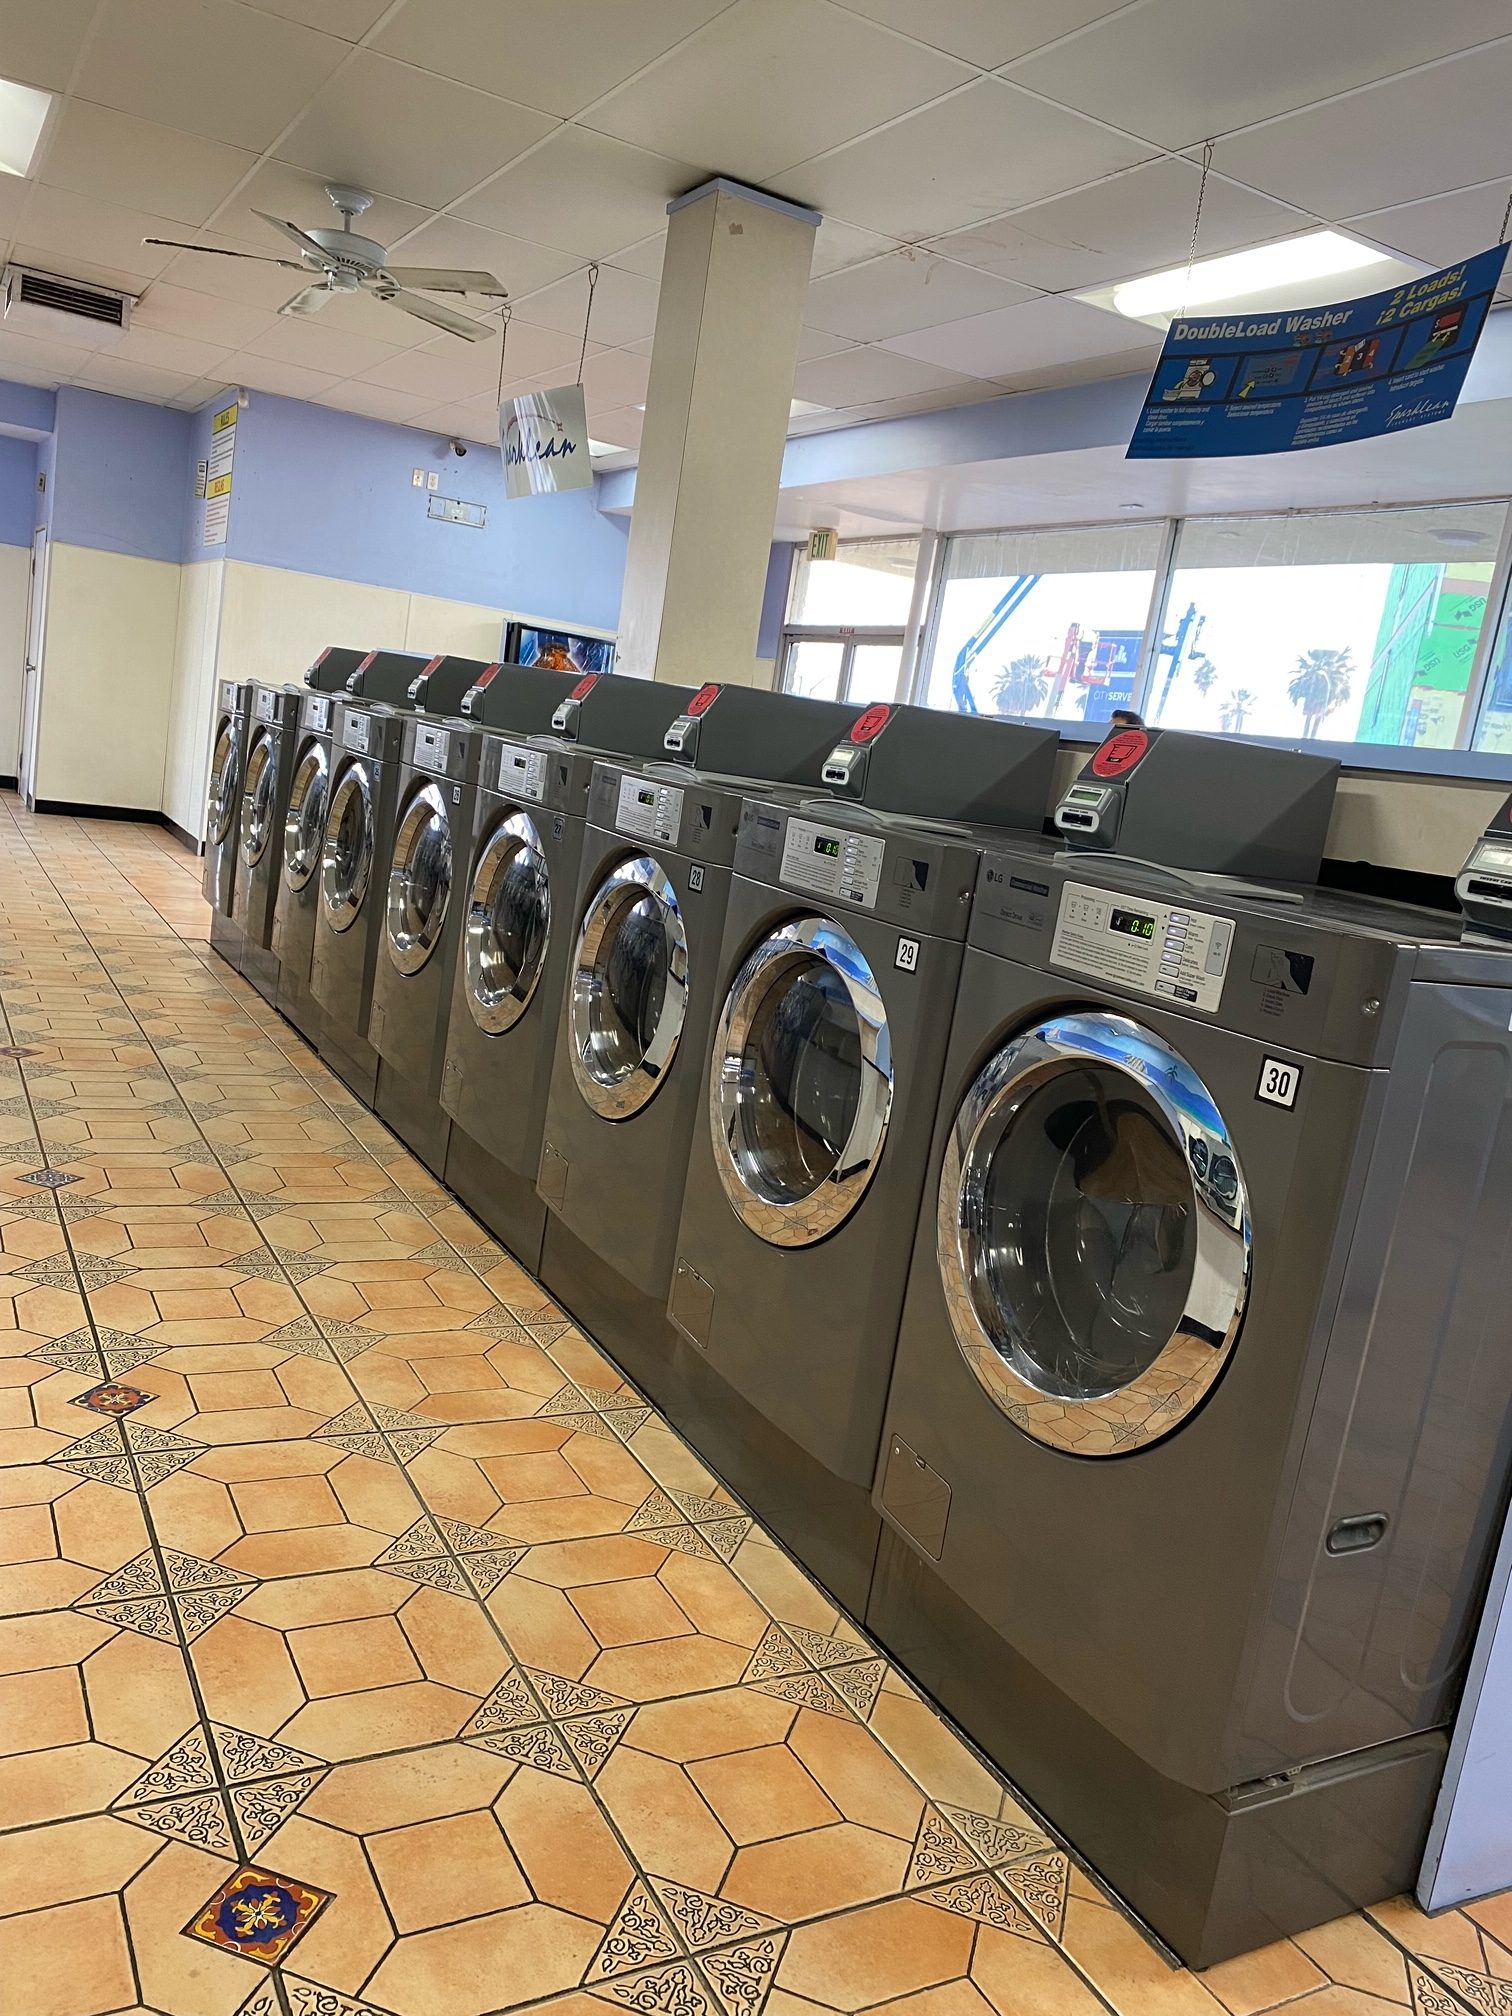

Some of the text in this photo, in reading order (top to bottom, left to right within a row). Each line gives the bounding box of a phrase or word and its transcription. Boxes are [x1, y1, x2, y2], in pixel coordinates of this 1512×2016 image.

[1390, 264, 1467, 306] 2 Loads!
[1399, 280, 1468, 318] Cargas!
[1173, 309, 1353, 341] DoubleLoad Washer
[811, 533, 830, 559] EXIT
[1468, 597, 1489, 614] USG
[1452, 645, 1472, 660] USG
[1423, 657, 1441, 672] USG
[554, 823, 562, 835] 27
[691, 869, 702, 887] 28
[994, 872, 1004, 884] LG
[899, 943, 914, 965] 29
[1266, 1067, 1291, 1098] 30
